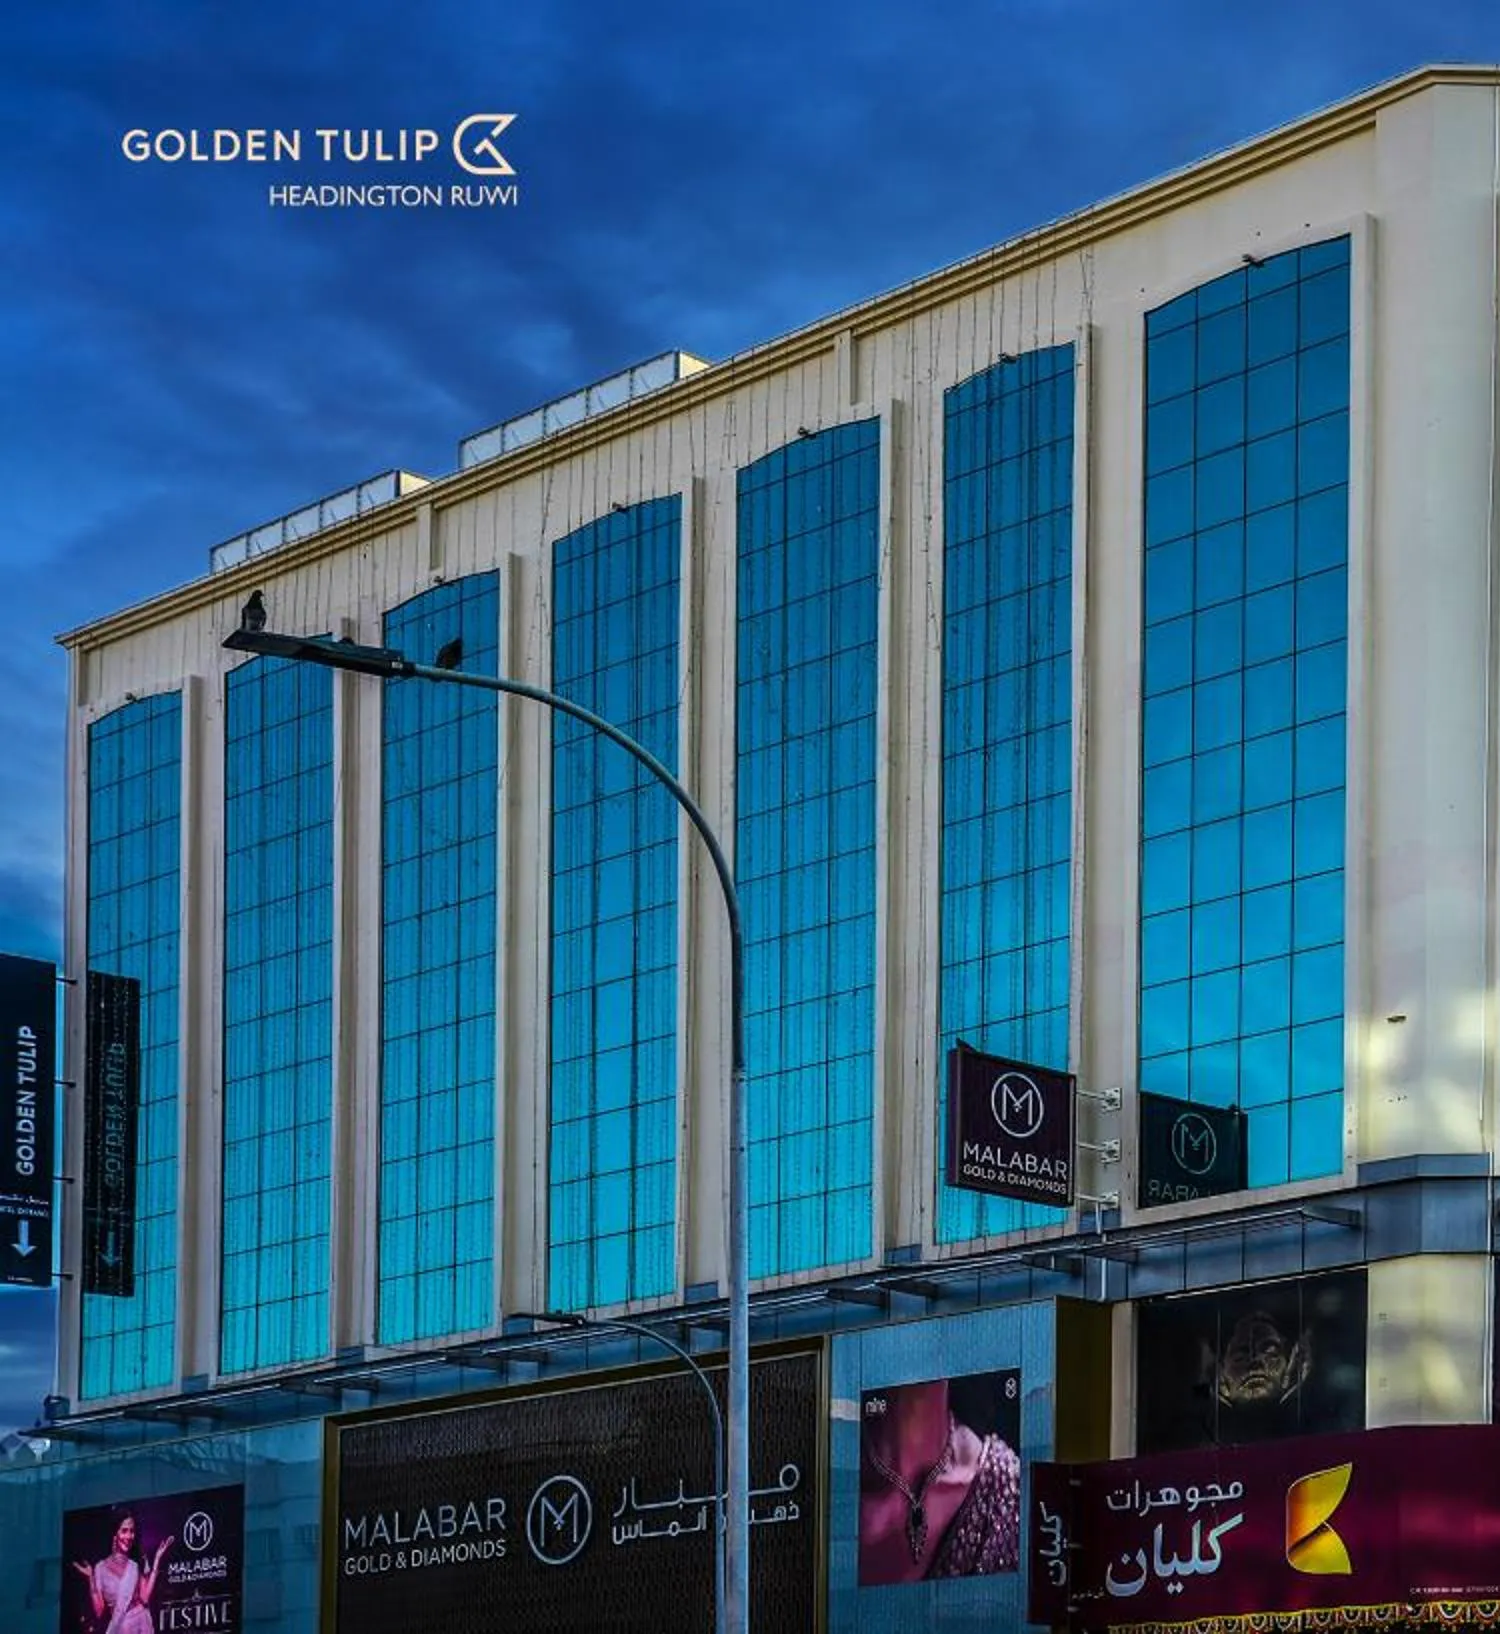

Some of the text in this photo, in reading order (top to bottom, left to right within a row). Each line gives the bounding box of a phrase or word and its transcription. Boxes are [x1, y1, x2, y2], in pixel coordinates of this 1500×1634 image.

[17, 1025, 38, 1085] TULIP
[15, 1090, 36, 1177] GOLDEN
[963, 1141, 1067, 1180] MALABAR
[963, 1164, 1067, 1195] GOLD & DIAMONDS
[1106, 1480, 1244, 1517] مجوهرات
[344, 1498, 507, 1550] MALABAR
[344, 1539, 506, 1575] GOLD & DIAMONDS
[1105, 1513, 1244, 1597] كليان
